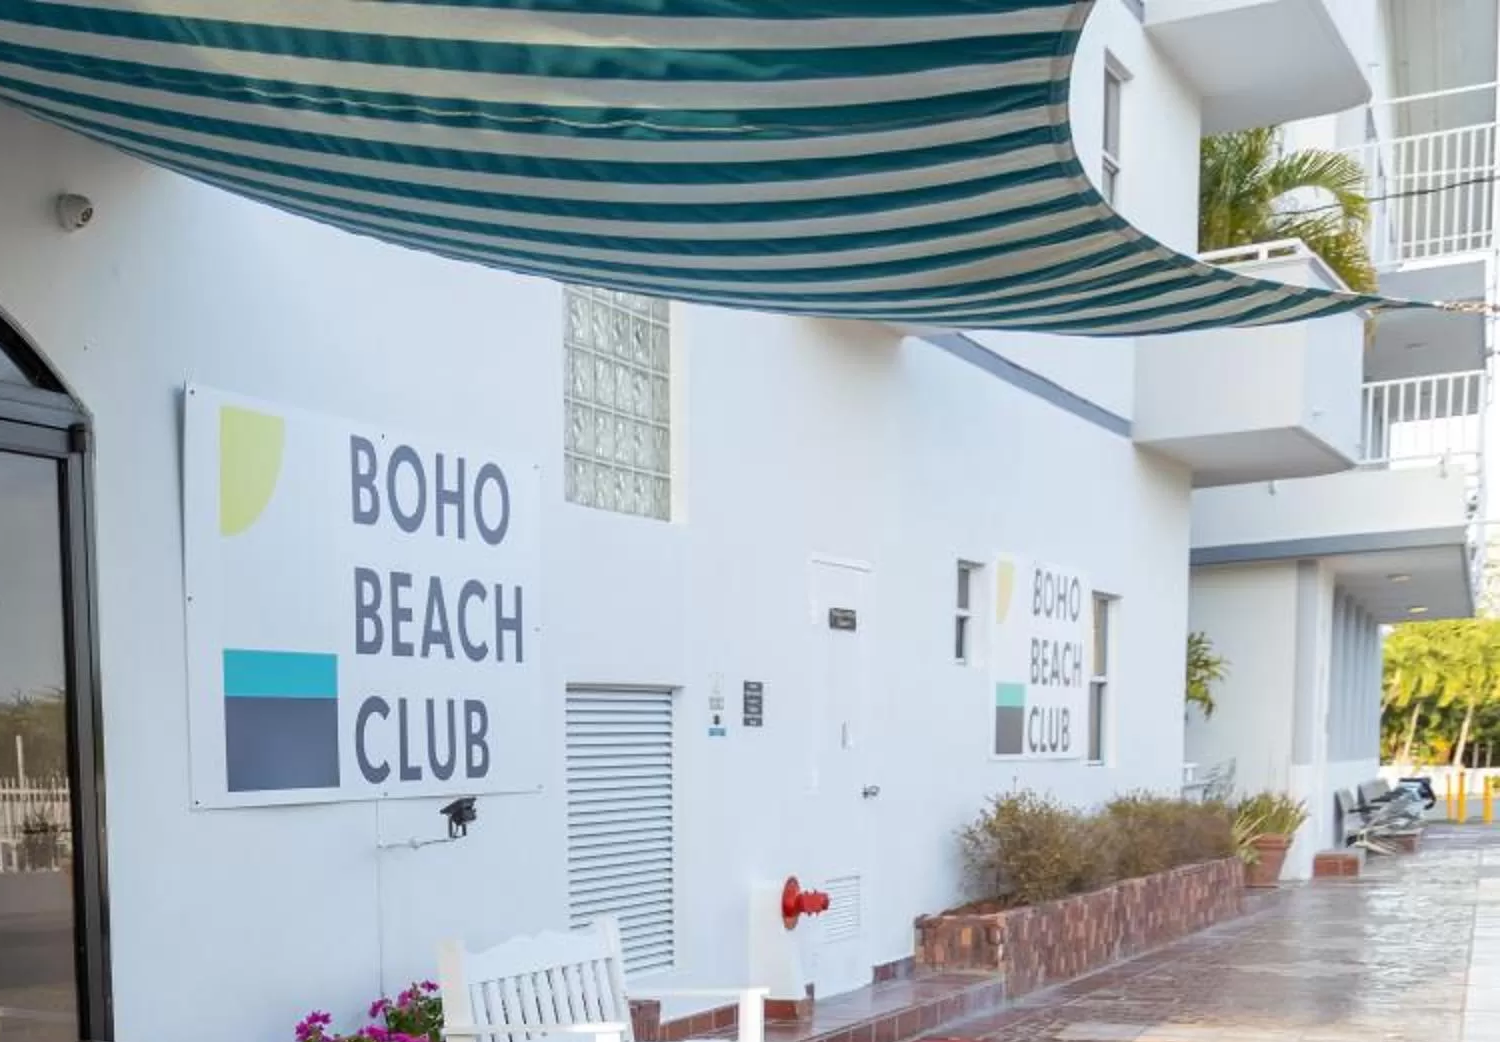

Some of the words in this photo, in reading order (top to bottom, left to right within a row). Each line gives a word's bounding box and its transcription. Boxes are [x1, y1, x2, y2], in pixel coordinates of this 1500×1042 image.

[350, 434, 509, 545] BOHO
[354, 566, 523, 663] BEACH
[1032, 568, 1081, 622] BOHO
[1031, 637, 1082, 688] BEACH
[355, 695, 489, 784] CLUB
[1028, 705, 1071, 753] CLUB
